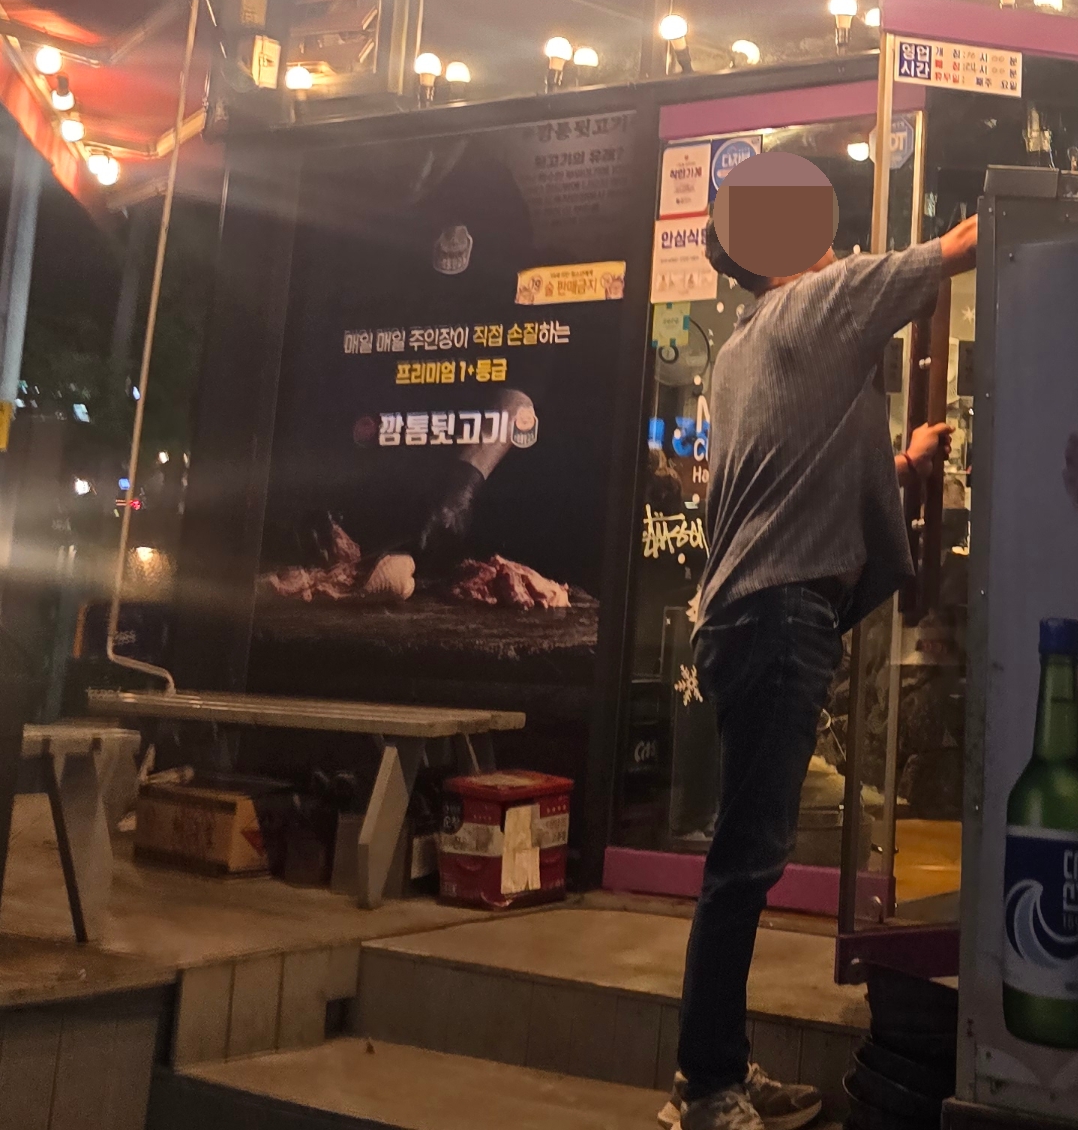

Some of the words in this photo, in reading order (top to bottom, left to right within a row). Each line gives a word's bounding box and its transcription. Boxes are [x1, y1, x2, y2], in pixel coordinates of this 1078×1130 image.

[901, 43, 930, 61] 영업
[900, 60, 930, 78] 시간
[344, 329, 373, 353] 매일
[376, 329, 405, 353] 매일
[408, 326, 469, 351] 주인장이
[472, 324, 503, 346] 직접
[507, 320, 571, 346] 손질하는
[395, 360, 455, 385] 프리미엄
[378, 411, 509, 446] 깡통뒷고기
